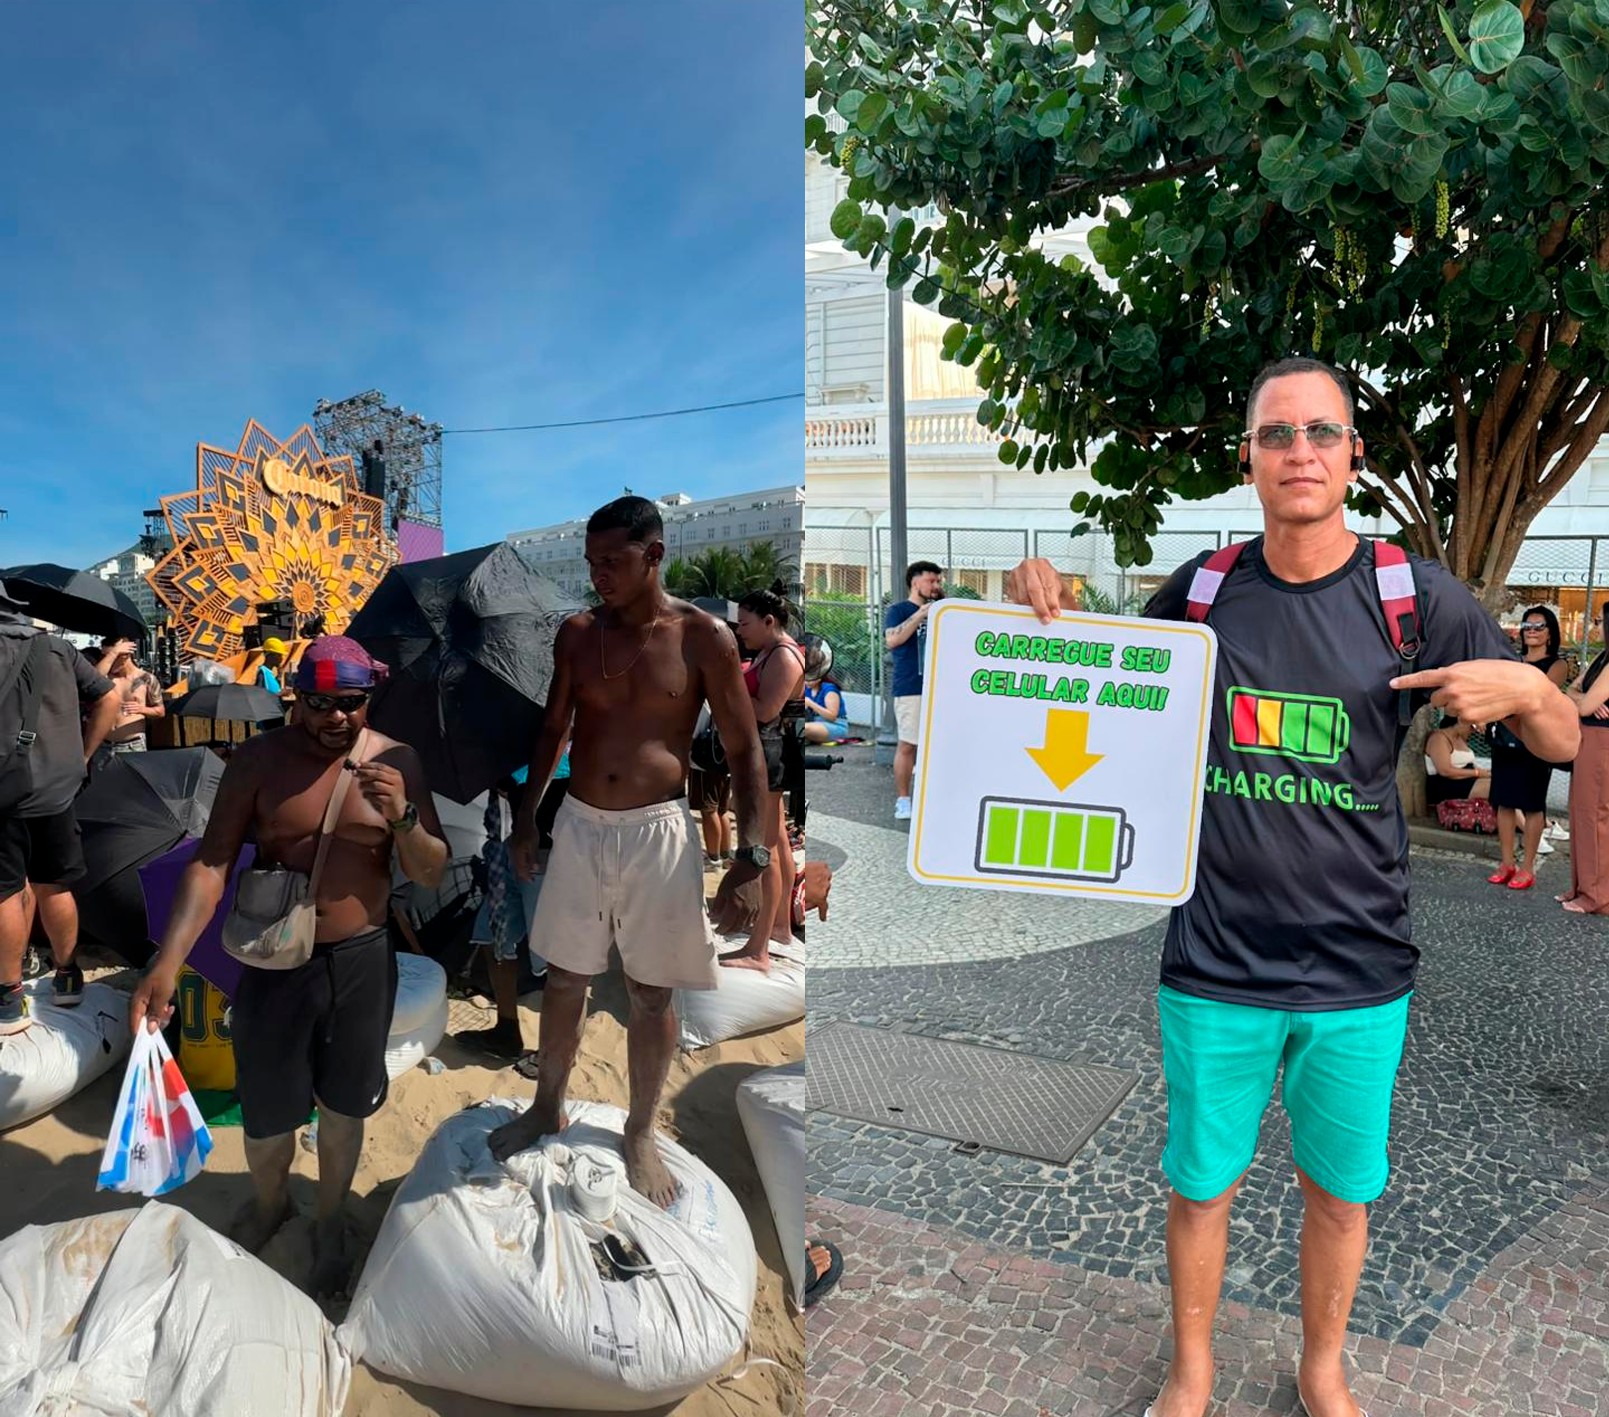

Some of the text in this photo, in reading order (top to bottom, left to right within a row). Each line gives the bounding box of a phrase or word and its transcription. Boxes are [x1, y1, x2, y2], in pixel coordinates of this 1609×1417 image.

[975, 630, 1172, 674] CARREGUE SEU
[970, 668, 1090, 704] CELULAR
